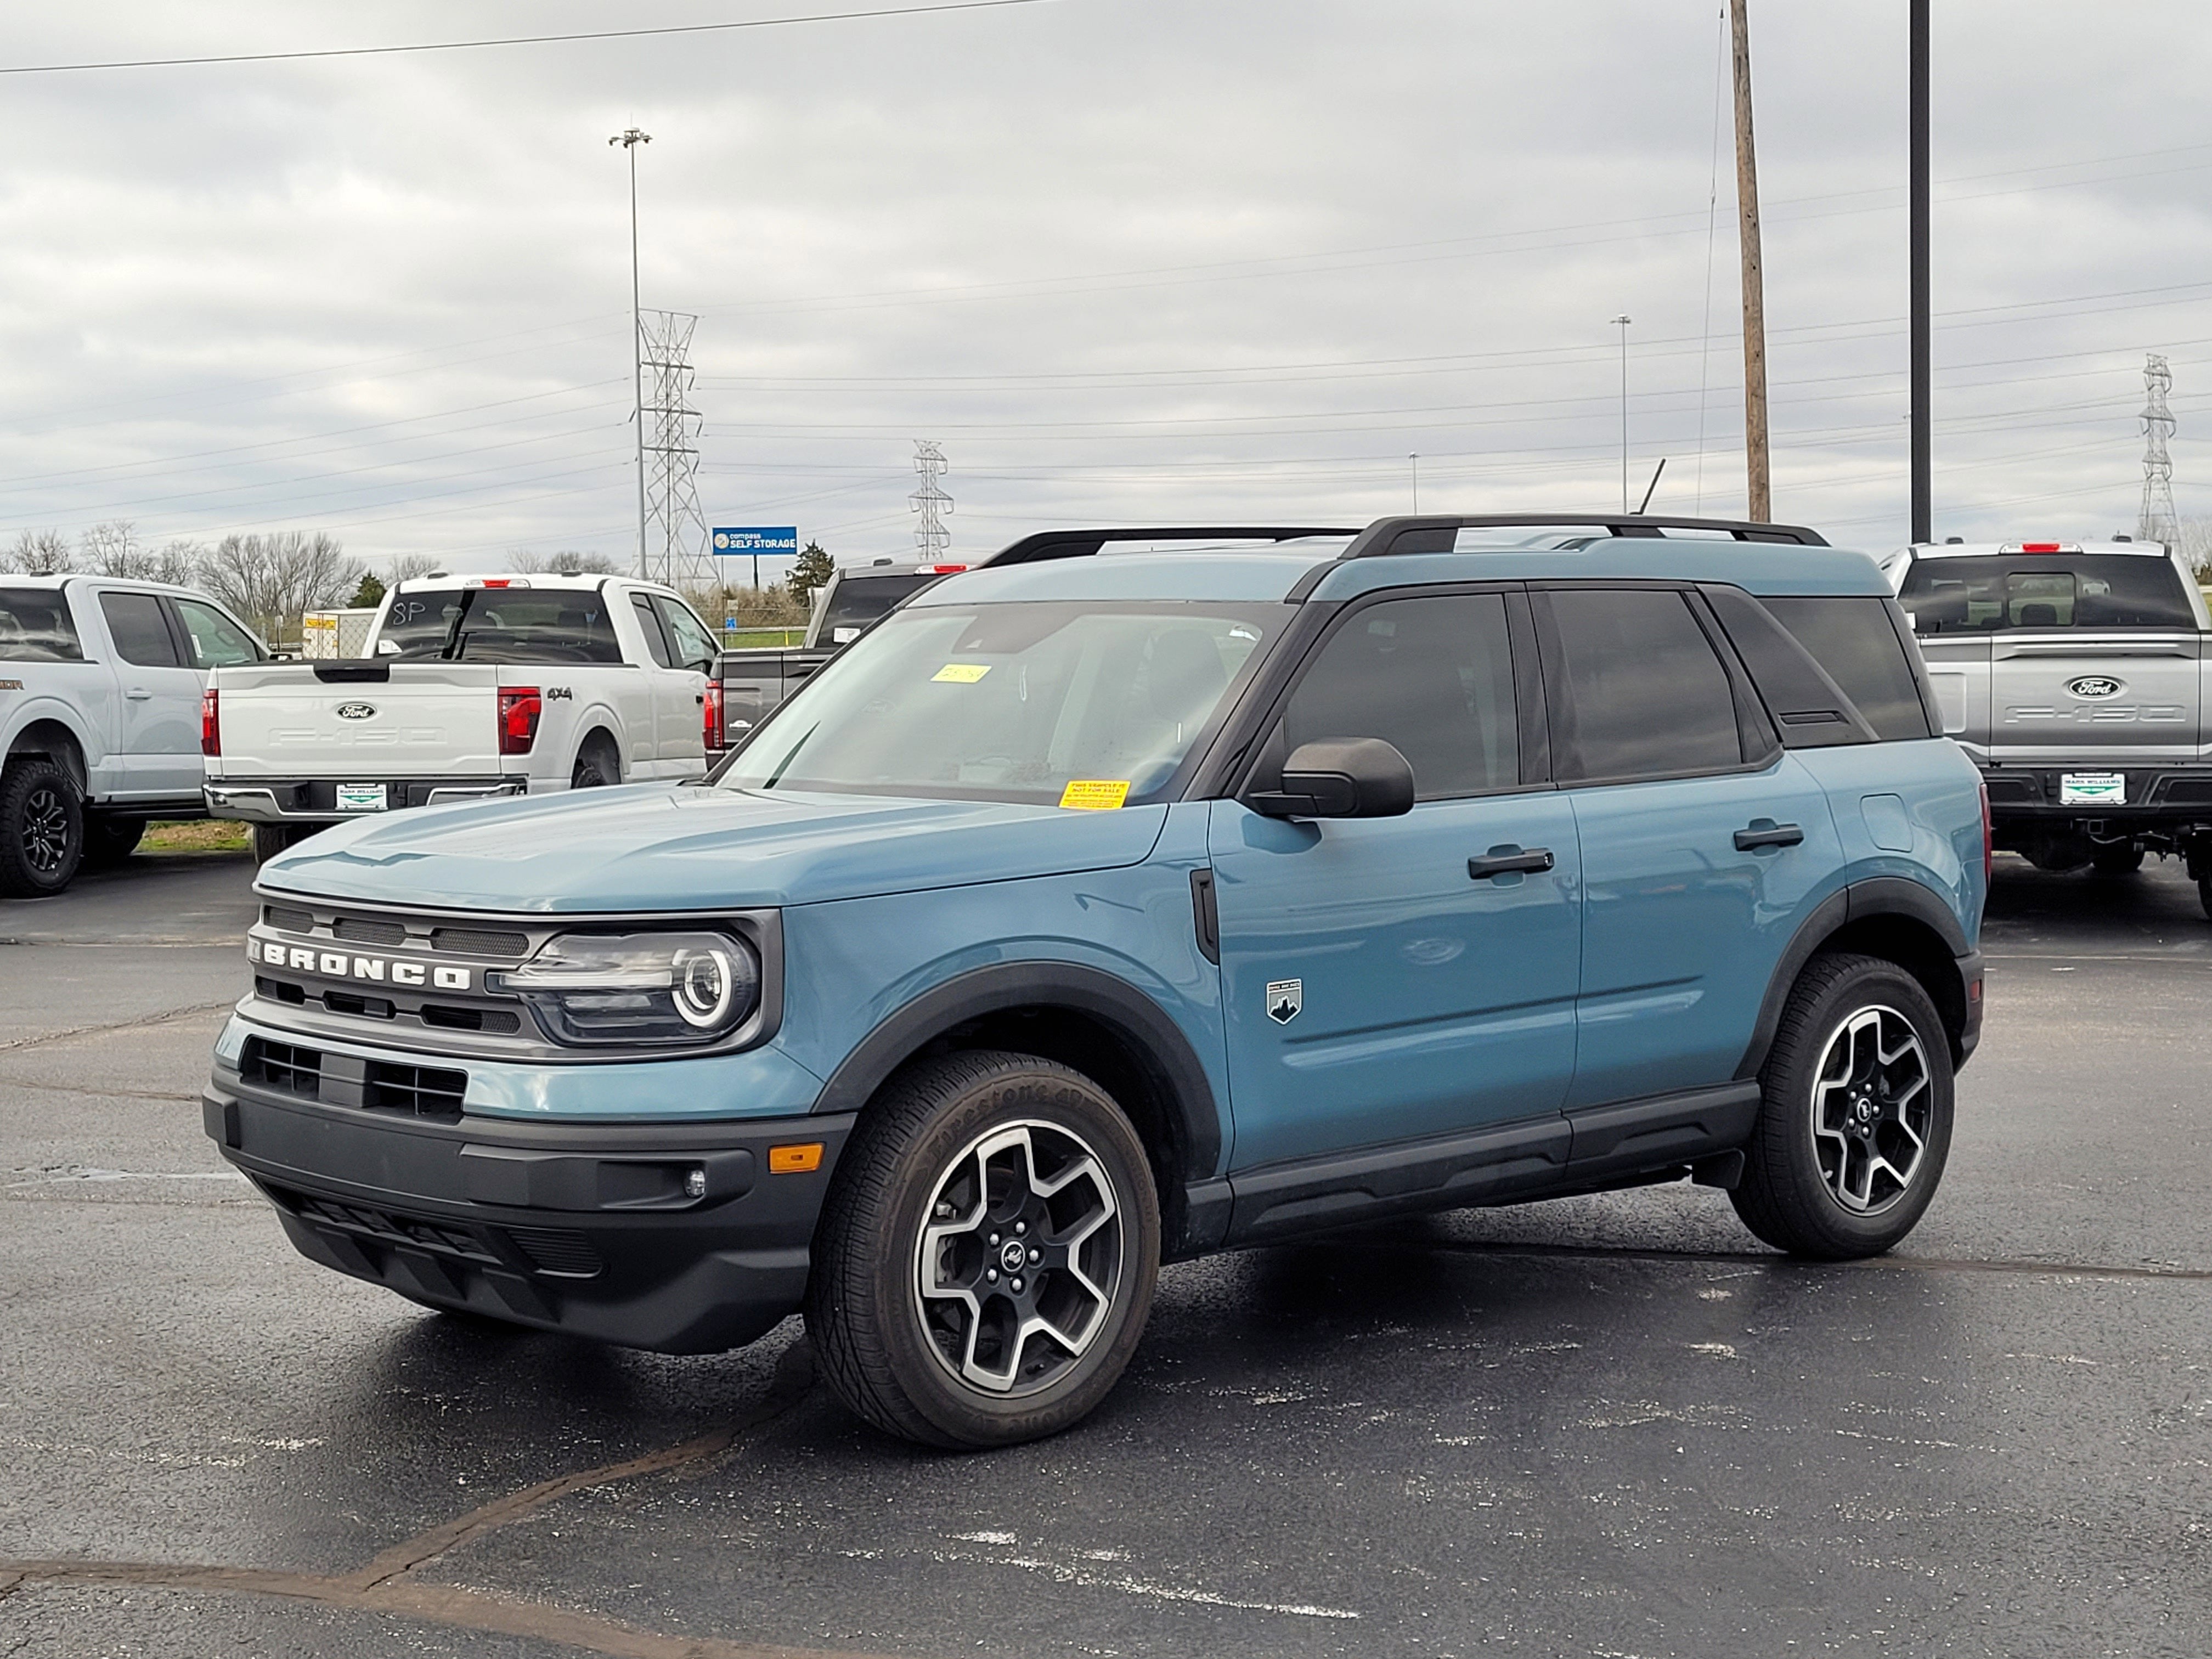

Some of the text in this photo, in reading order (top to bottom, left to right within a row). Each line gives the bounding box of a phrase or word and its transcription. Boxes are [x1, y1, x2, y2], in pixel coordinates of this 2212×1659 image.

[730, 539, 796, 548] SELF STORAGE
[2077, 680, 2112, 695] Ford
[341, 705, 370, 718] Ford
[2004, 706, 2186, 723] F-150
[268, 727, 448, 746] F-150
[263, 943, 471, 990] BRONCO
